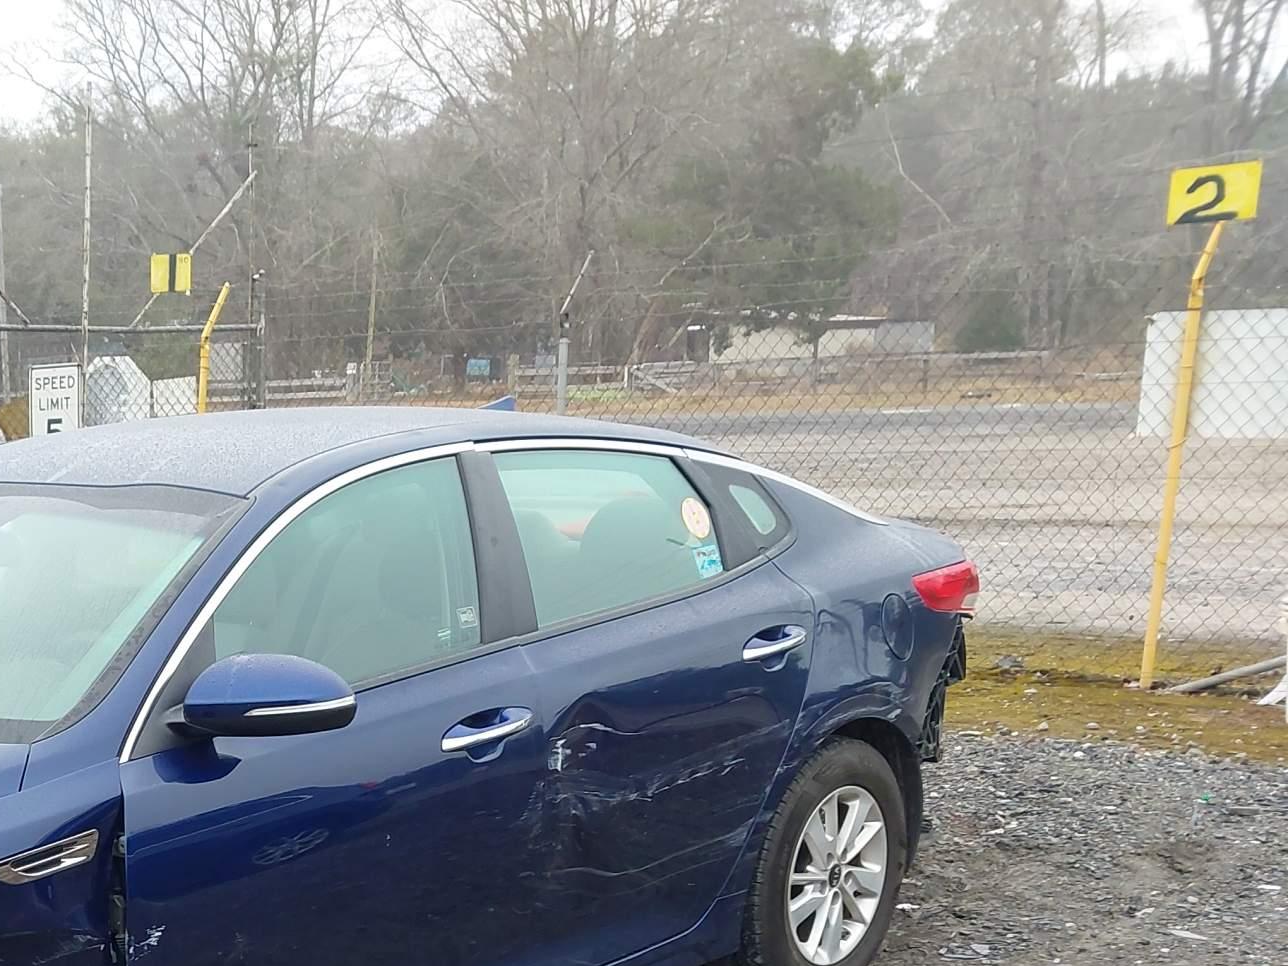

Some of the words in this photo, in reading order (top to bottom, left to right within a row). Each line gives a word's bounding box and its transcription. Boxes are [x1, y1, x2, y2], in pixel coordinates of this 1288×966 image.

[1174, 173, 1239, 226] 2
[34, 375, 76, 391] SPEED
[38, 396, 71, 412] LIMIT
